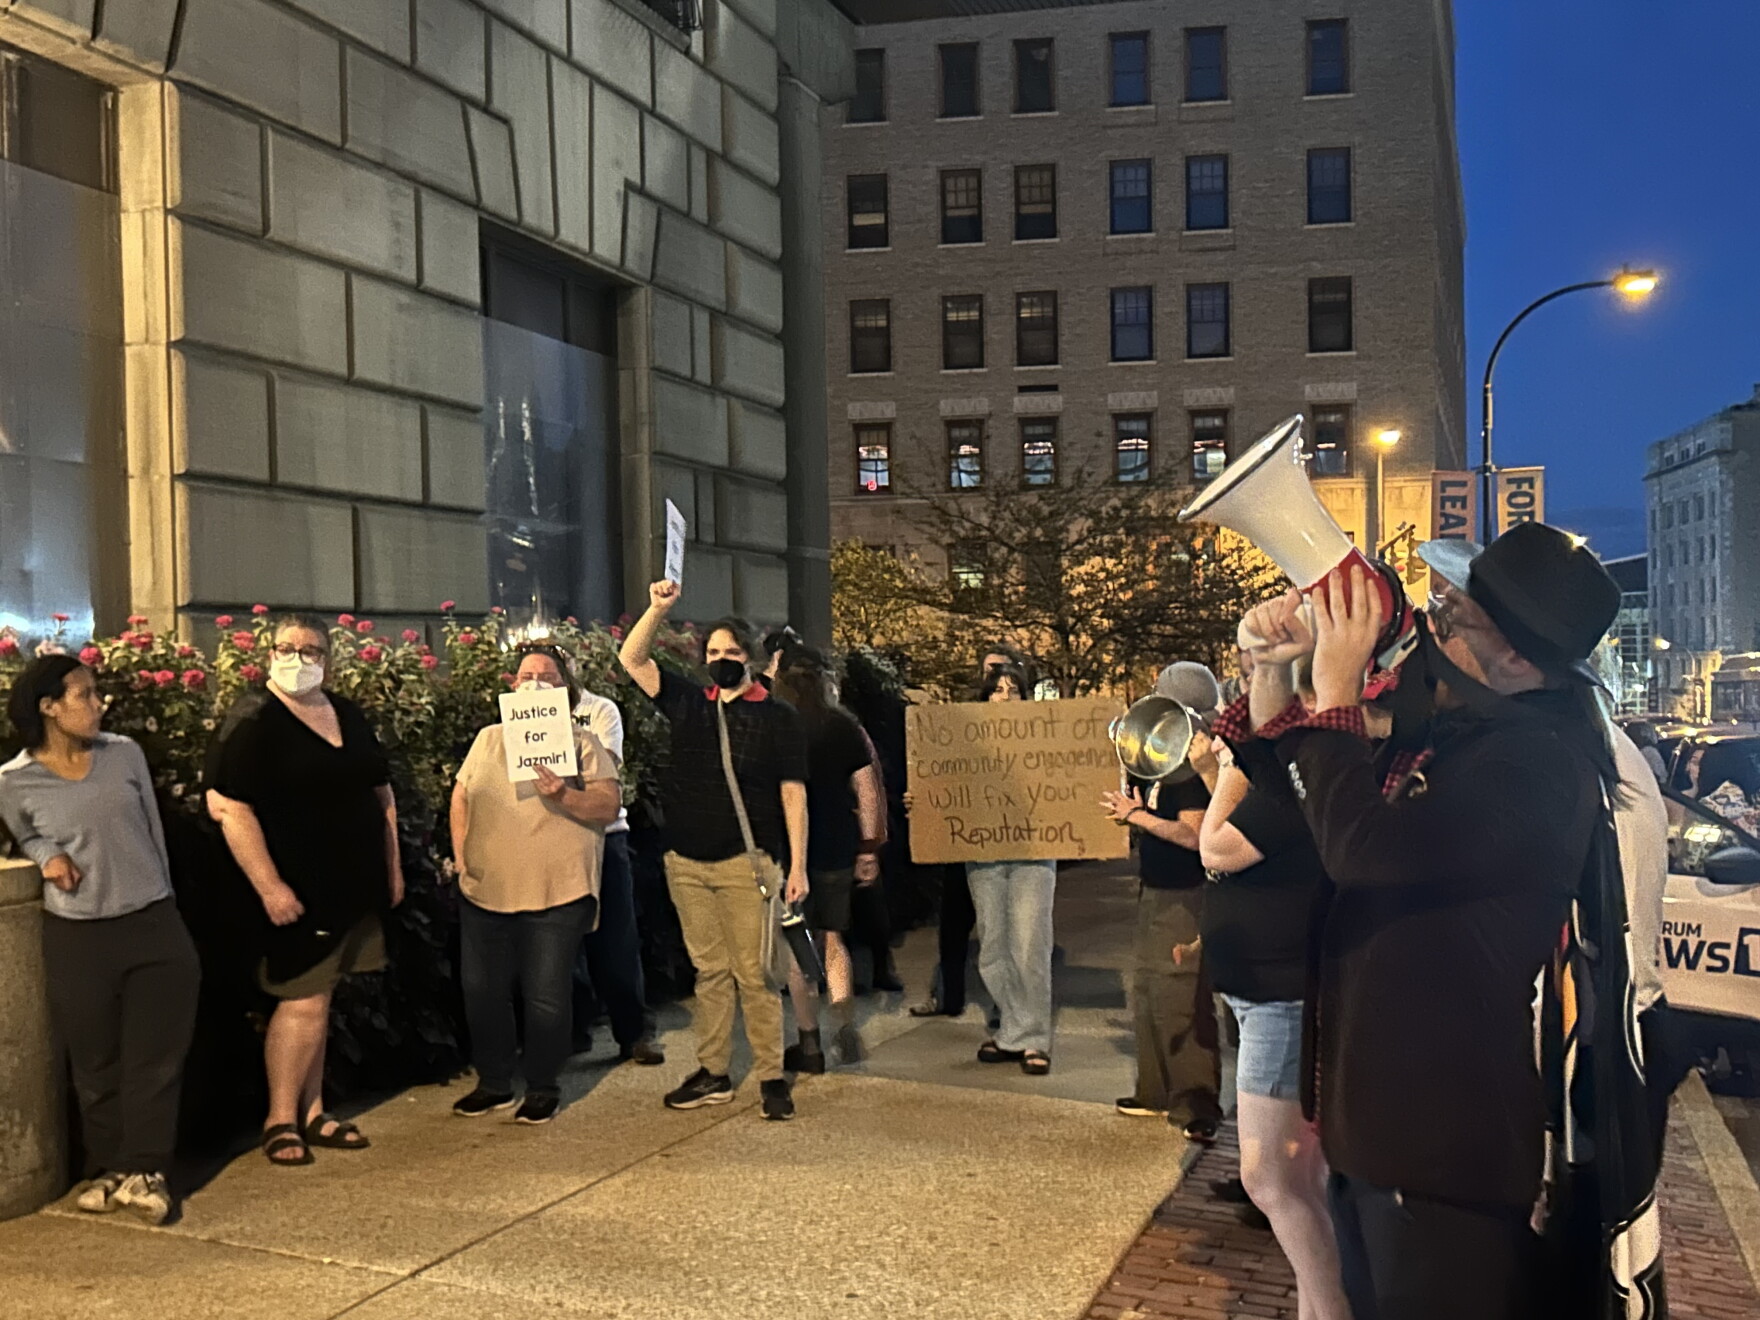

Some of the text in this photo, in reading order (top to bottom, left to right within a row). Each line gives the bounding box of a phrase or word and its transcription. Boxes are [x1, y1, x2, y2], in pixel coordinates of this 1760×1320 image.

[1439, 480, 1468, 540] LEA
[509, 706, 558, 721] Justice
[916, 707, 1109, 747] No amount of
[524, 730, 548, 744] for
[1023, 747, 1119, 779] engagemen
[983, 785, 1016, 810] fix
[1027, 782, 1087, 816] your
